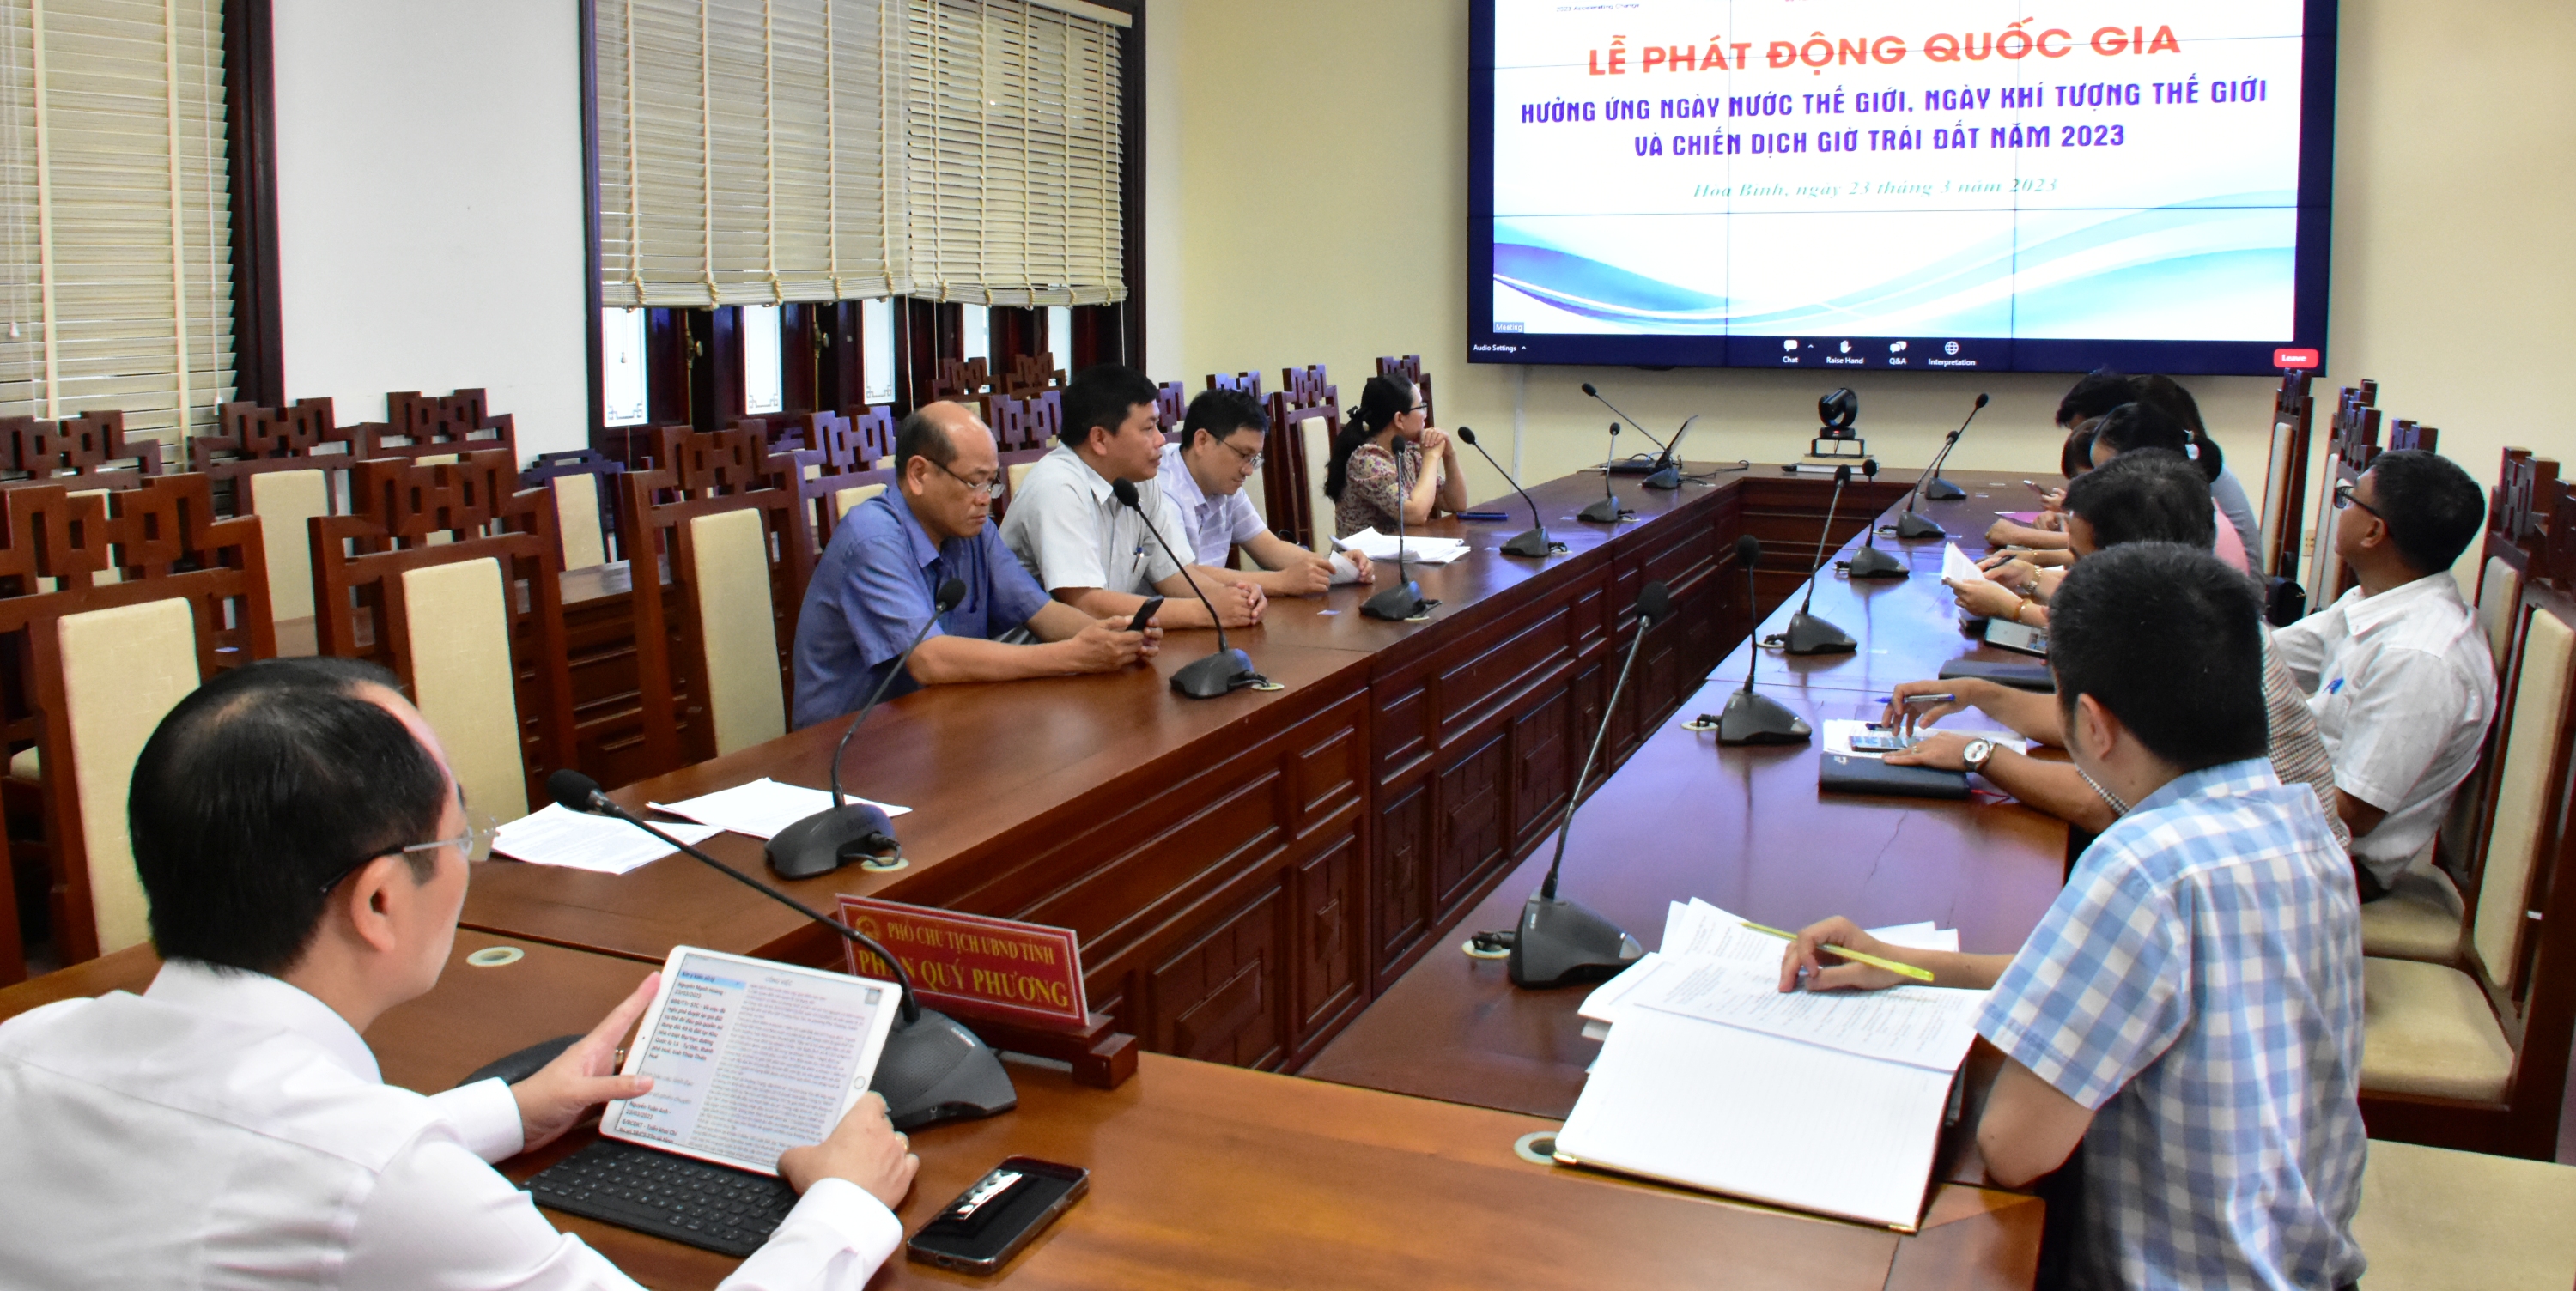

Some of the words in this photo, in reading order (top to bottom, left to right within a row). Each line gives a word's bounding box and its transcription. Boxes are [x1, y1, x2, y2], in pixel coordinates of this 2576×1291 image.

[1589, 34, 1626, 76] LỄ
[1643, 34, 1752, 74] PHÁT
[1765, 30, 1907, 76] ĐỘNG
[1923, 15, 2073, 63] QUỐC
[2090, 24, 2182, 57] GIA
[1521, 96, 1595, 124] HƯỞNG
[1605, 96, 1650, 121] ỨNG
[1660, 93, 1720, 119] NGÀY
[1728, 90, 1793, 118] NƯỚC
[1802, 84, 1845, 115] THẾ
[1855, 87, 1914, 113] GIỚI,
[1924, 84, 1990, 112] NGÀY
[2000, 81, 2044, 109] KHÍ
[2054, 82, 2141, 112] TƯỢNG
[2152, 72, 2199, 105] THẾ
[2210, 74, 2268, 103] GIỚI
[1634, 131, 1662, 157] VÀ
[1672, 125, 1741, 156] CHIẾN
[1751, 132, 1807, 159] DỊCH
[1817, 126, 1859, 153] GIỜ
[1868, 124, 1922, 152] TRÁI
[1933, 119, 1980, 150] ĐẤT
[1990, 122, 2050, 149] NĂM
[2060, 124, 2125, 148] 2023
[1796, 181, 1841, 199] ngày
[1848, 180, 1871, 196] 23
[1876, 179, 1933, 198] tháng
[1940, 179, 1953, 194] 3
[1957, 179, 2002, 194] năm
[2008, 178, 2058, 193] 2023
[1496, 324, 1523, 332] Meeting
[1492, 344, 1516, 353] Settings
[1845, 356, 1864, 365] Hand
[1889, 357, 1907, 366] Q&A
[1928, 358, 1977, 367] Interpretation
[2281, 354, 2307, 362] Leave
[887, 919, 914, 942] PHÓ
[945, 930, 980, 955] TỊCH
[981, 936, 1018, 960] UBND
[859, 949, 916, 979] PHN
[920, 957, 965, 992] QUÝ
[972, 967, 1069, 1008] PHƯƠNG
